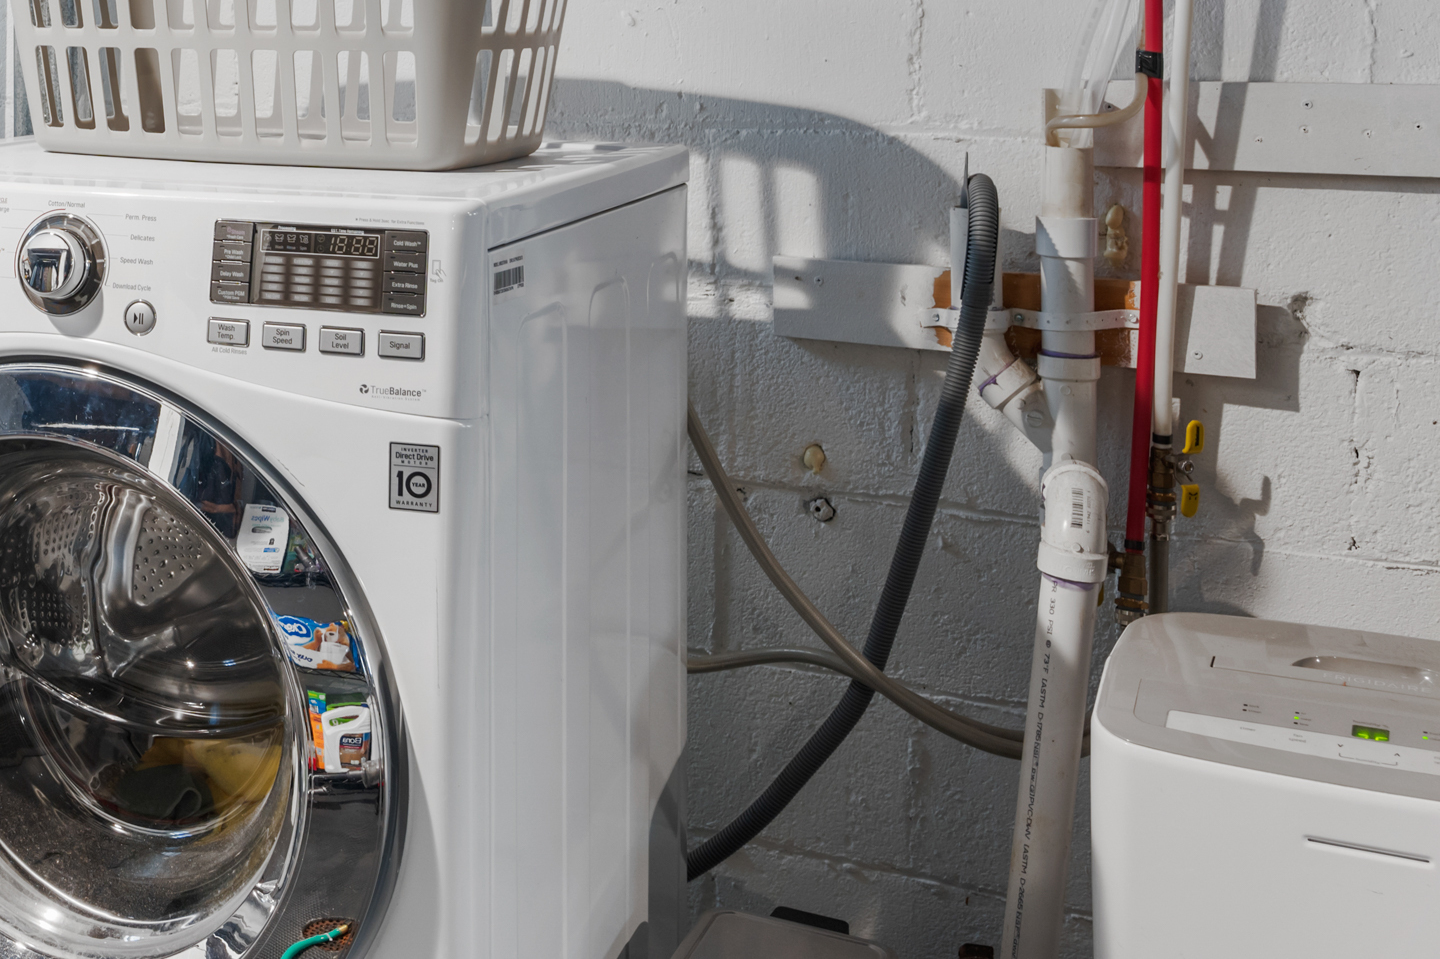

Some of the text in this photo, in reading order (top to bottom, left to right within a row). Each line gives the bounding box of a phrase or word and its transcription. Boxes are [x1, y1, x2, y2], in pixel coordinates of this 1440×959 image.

[113, 282, 137, 290] Download
[218, 324, 235, 332] Wash
[217, 332, 234, 340] Temp.
[276, 329, 290, 337] Spin
[335, 333, 346, 341] Soil
[273, 336, 292, 345] Speed
[331, 341, 349, 349] Level
[389, 341, 410, 350] Signal
[396, 452, 434, 462] Direct Drive
[396, 471, 432, 498] 10
[1051, 581, 1057, 593] PR
[1046, 619, 1054, 636] PSI
[1323, 673, 1431, 693] FRIGIDAIRE
[1035, 712, 1043, 742] D-1785
[1017, 878, 1026, 910] D-2665
